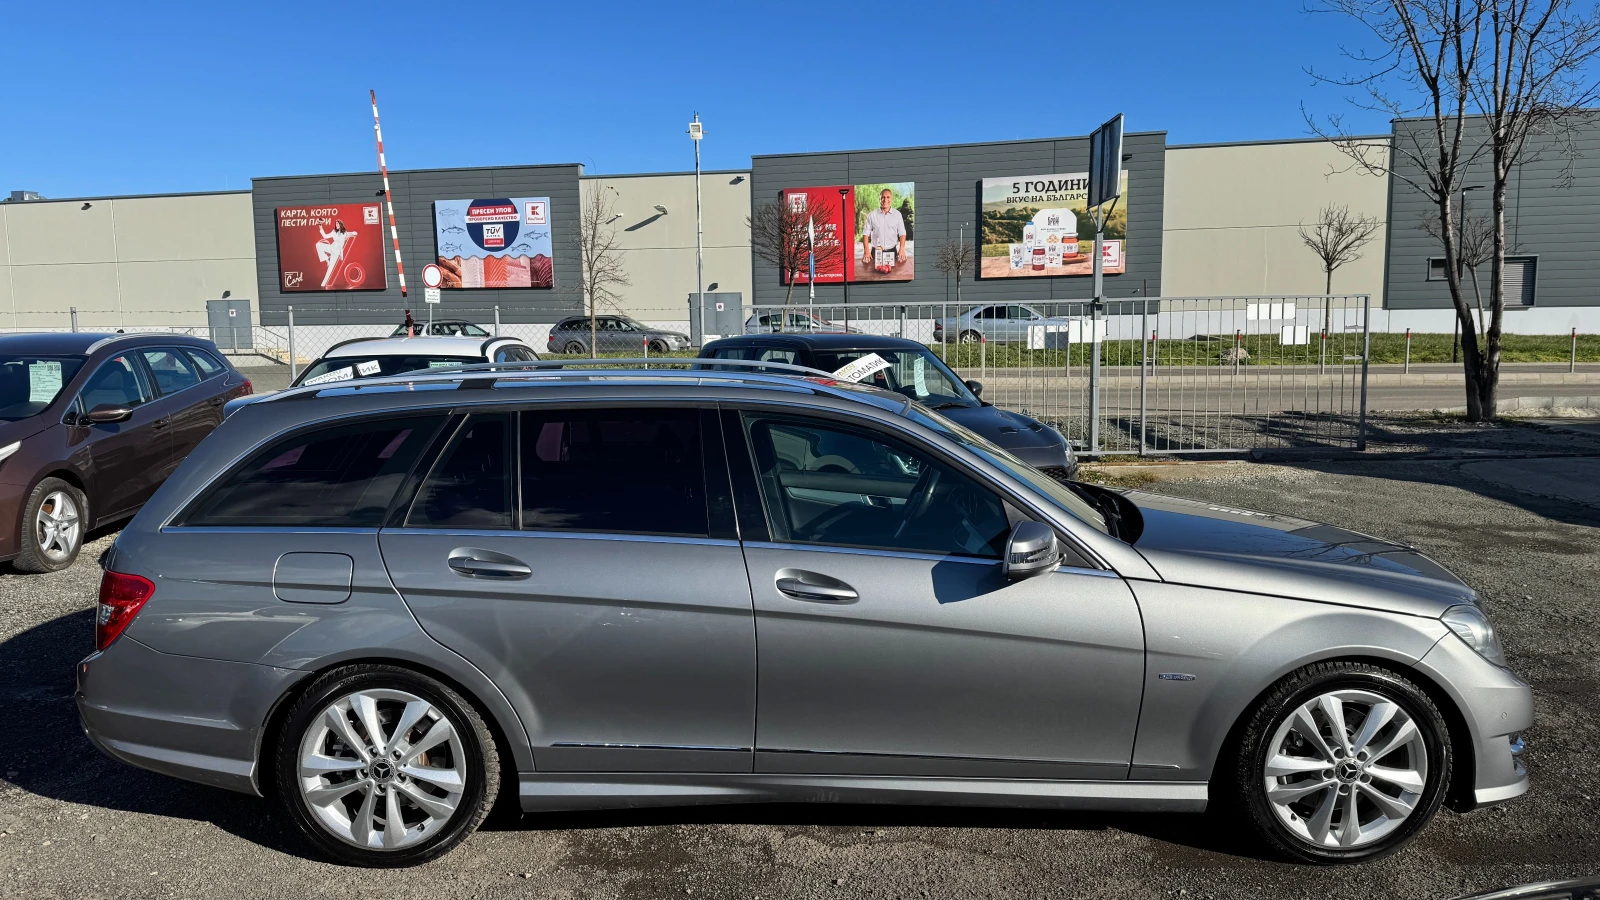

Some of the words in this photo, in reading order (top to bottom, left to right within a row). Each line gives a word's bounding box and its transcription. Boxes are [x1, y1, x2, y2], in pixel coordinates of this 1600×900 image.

[1012, 182, 1020, 194] 5
[1006, 196, 1030, 204] ВКУС
[1046, 193, 1089, 202] БЪЛГАРС
[280, 209, 308, 218] КАРТА,
[310, 208, 338, 217] КОЯТО
[281, 219, 307, 227] ПЕСТИ
[846, 357, 886, 382] ТОМАТИК
